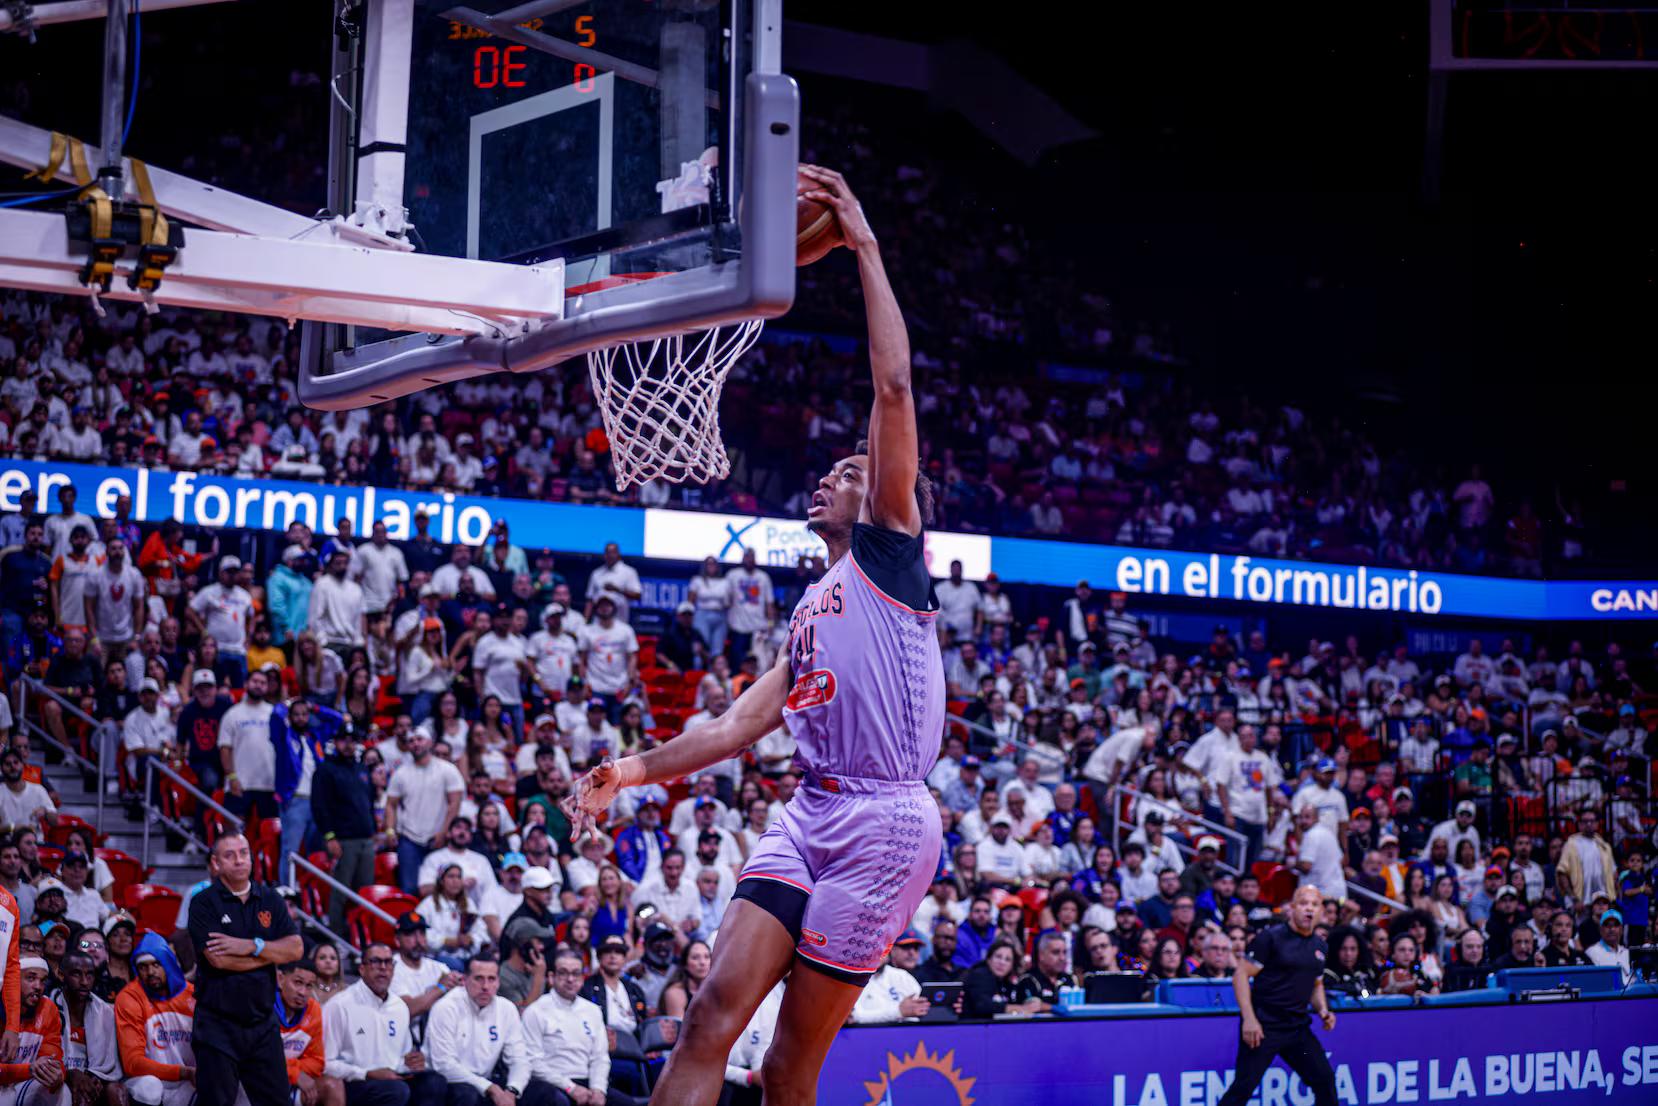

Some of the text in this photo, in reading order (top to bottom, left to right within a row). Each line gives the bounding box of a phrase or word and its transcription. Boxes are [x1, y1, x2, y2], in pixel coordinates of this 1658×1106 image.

[95, 466, 149, 522] el
[170, 470, 493, 546] formulario
[1116, 553, 1443, 615] en el formulario
[1591, 588, 1658, 612] CAN
[888, 986, 900, 1001] S
[388, 1020, 396, 1037] S
[488, 1025, 498, 1041] S
[582, 1020, 592, 1035] S
[751, 1030, 760, 1045] S
[1180, 1051, 1358, 1106] ENRGA
[1367, 1059, 1419, 1104] DE
[1429, 1057, 1477, 1101] LA
[1485, 1049, 1614, 1096] BUENA,
[1622, 1045, 1658, 1085] SE
